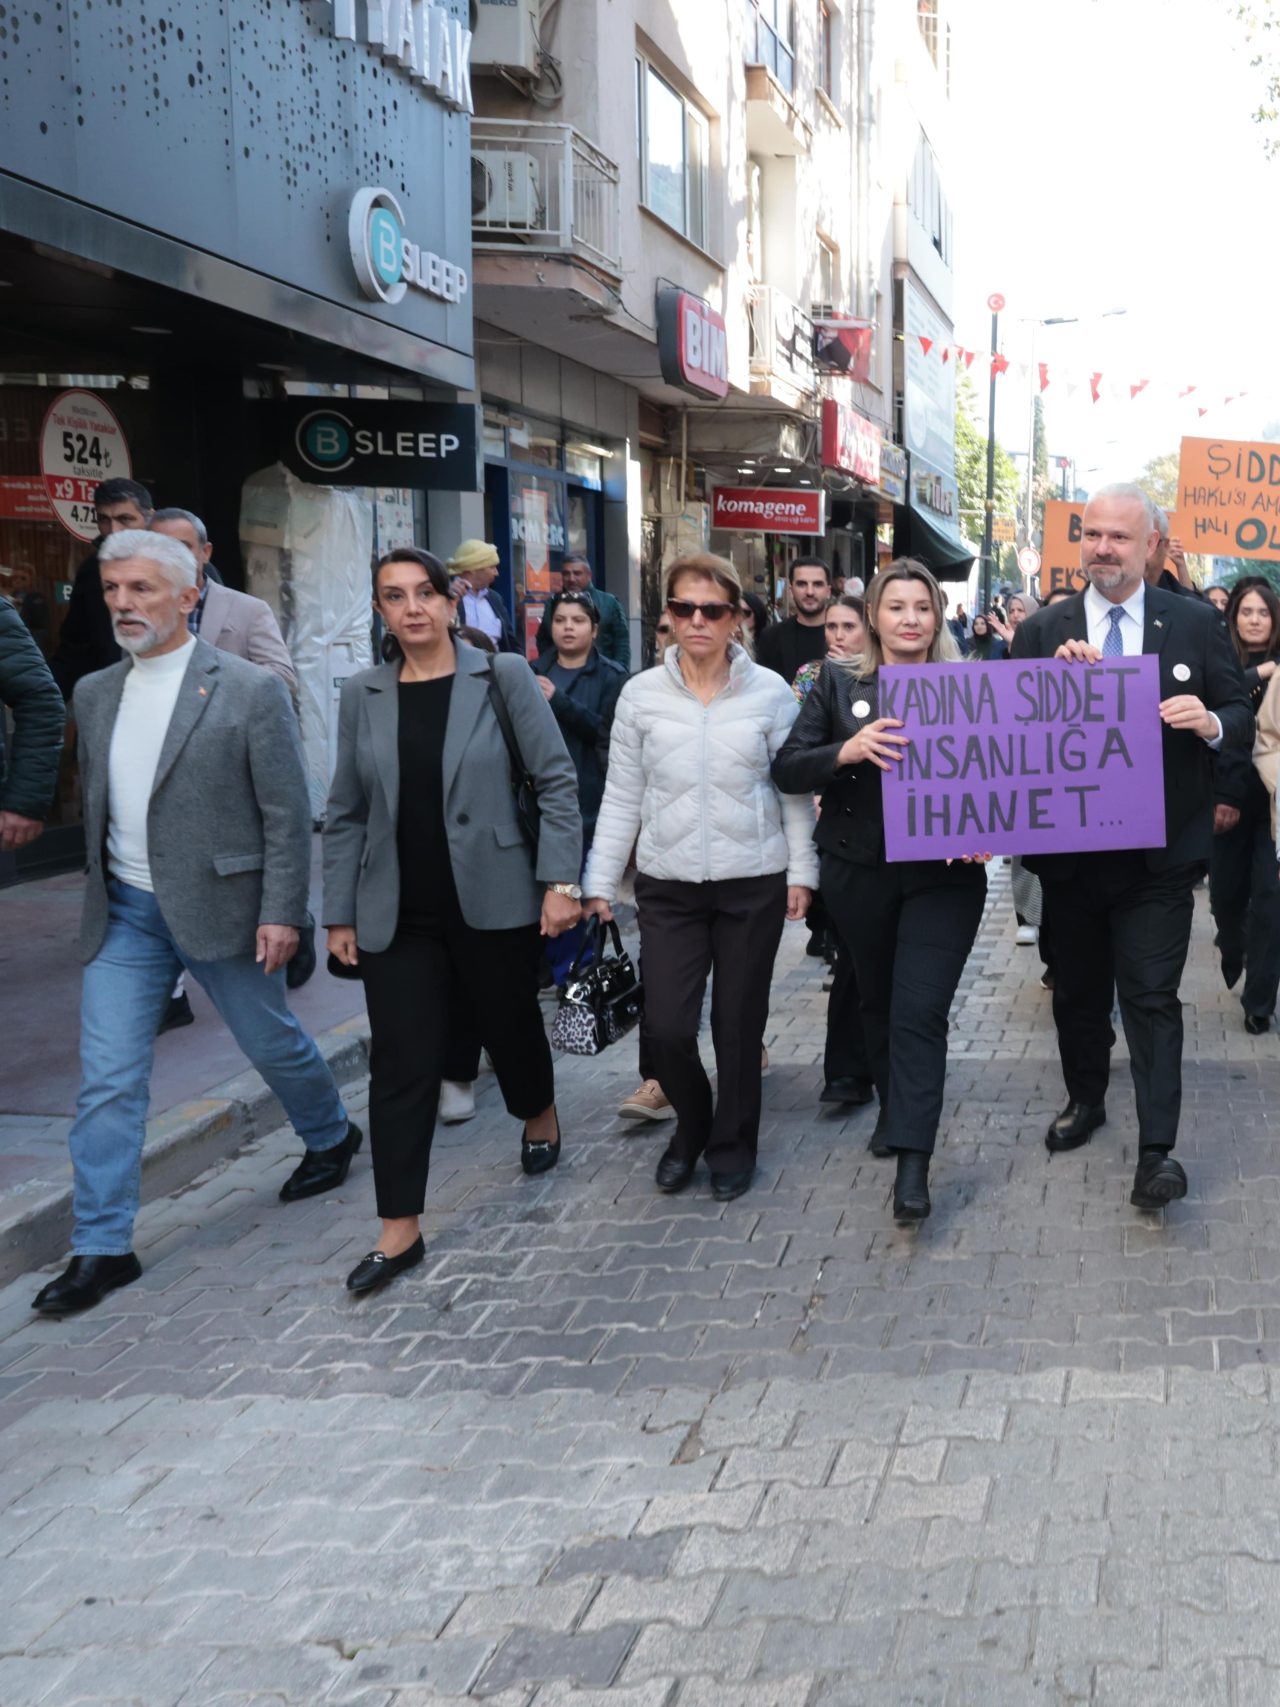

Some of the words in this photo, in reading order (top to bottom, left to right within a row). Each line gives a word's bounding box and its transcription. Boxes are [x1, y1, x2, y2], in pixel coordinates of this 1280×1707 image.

[400, 238, 467, 303] SLEEP
[685, 305, 727, 382] BİM
[355, 430, 460, 458] SLEEP
[73, 464, 104, 479] taksitle
[55, 479, 74, 499] x9
[717, 494, 807, 519] komagene
[881, 673, 998, 726] KADINA
[1014, 666, 1140, 726] ŞİDDET
